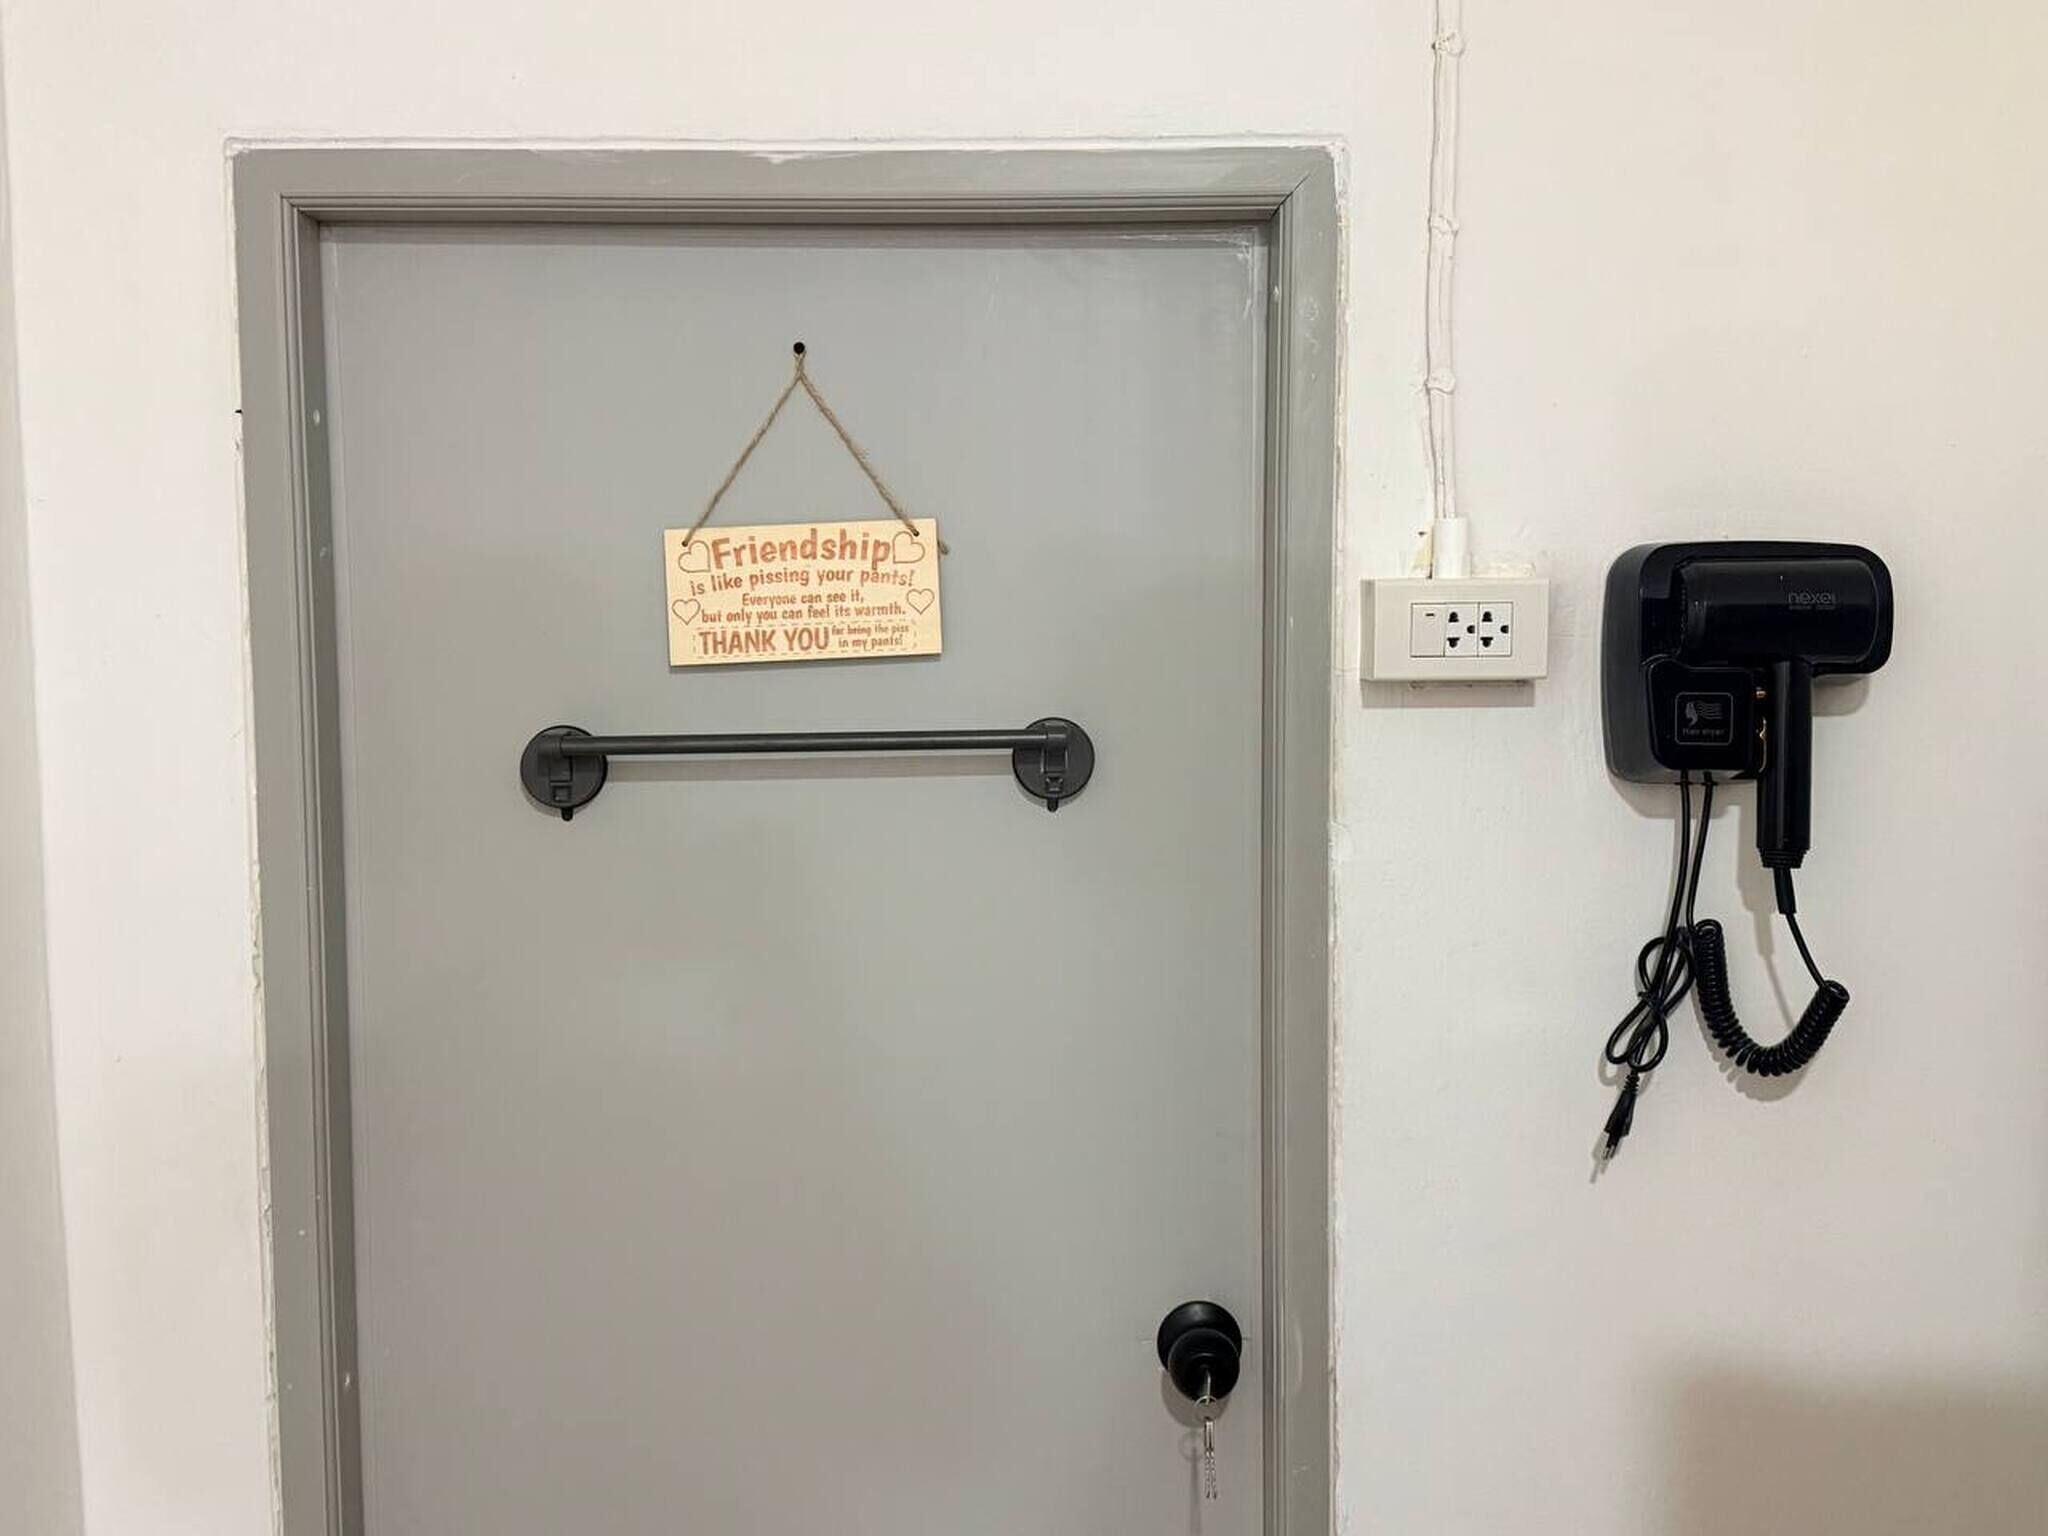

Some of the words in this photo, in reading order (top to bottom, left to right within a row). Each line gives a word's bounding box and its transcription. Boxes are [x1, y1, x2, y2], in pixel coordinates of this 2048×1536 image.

[711, 527, 891, 570] Friendship
[690, 581, 705, 596] is
[711, 573, 743, 592] like
[749, 567, 810, 589] pissing
[817, 568, 854, 586] your
[860, 568, 915, 587] pants!
[742, 592, 797, 609] Everyone
[801, 593, 822, 604] can
[826, 592, 846, 602] see
[850, 589, 864, 604] it,
[701, 609, 722, 623] but
[726, 607, 753, 624] only
[756, 610, 777, 624] you
[782, 608, 803, 620] can
[807, 605, 830, 619] feel
[834, 604, 852, 618] its
[854, 602, 907, 617] warmth.
[699, 628, 777, 655] THANK
[783, 626, 830, 651] YOU
[831, 624, 845, 636] for
[847, 624, 872, 637] being
[874, 623, 889, 634] the
[892, 623, 910, 636] piss
[838, 637, 849, 648] in
[851, 638, 868, 651] my
[871, 634, 904, 650] pants!
